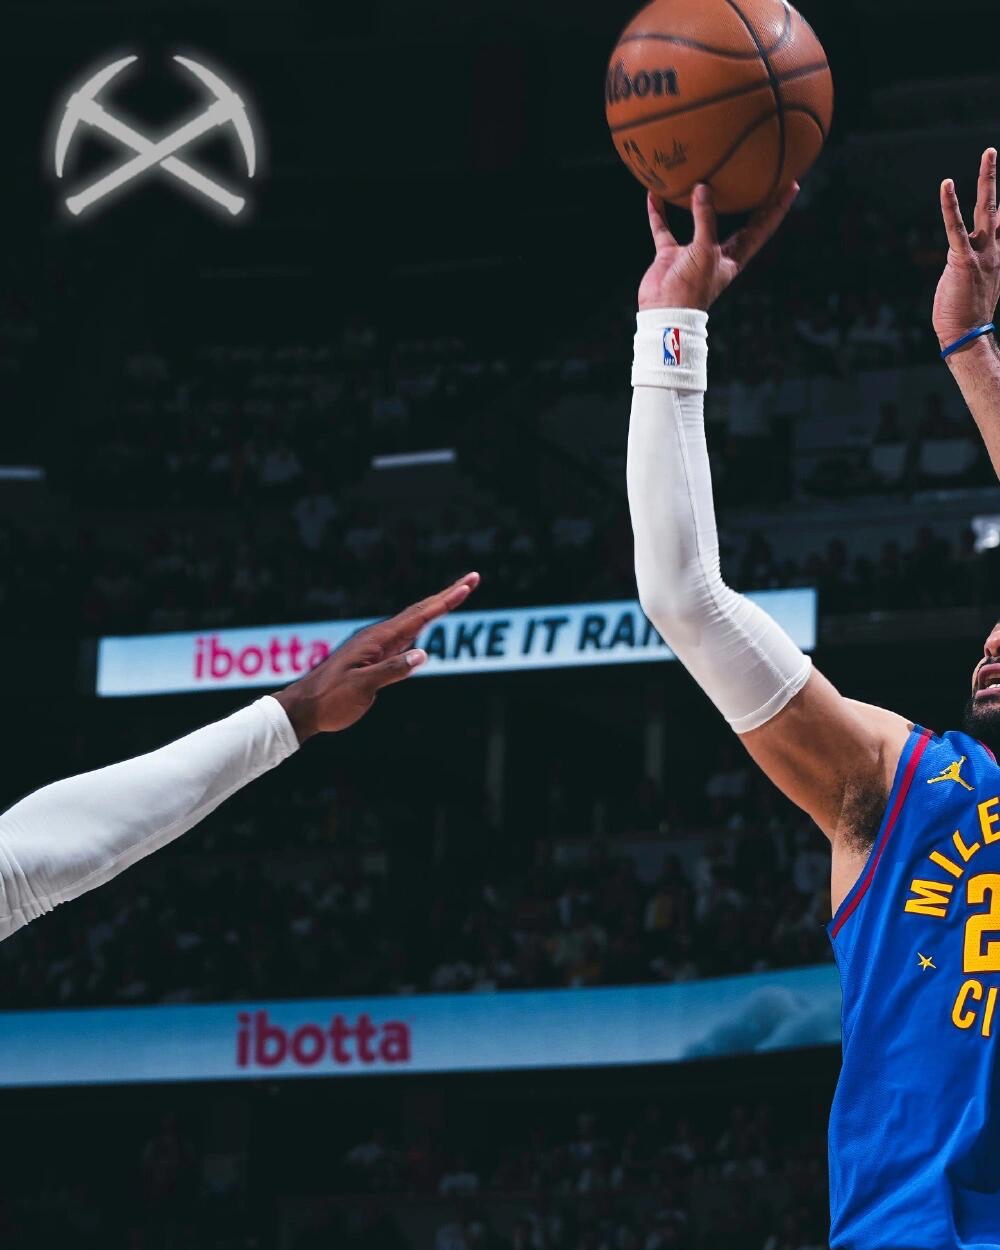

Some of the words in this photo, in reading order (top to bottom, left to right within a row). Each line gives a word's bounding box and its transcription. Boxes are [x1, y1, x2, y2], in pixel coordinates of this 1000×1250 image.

[413, 616, 512, 662] AKE
[522, 613, 570, 656] IT
[236, 1010, 410, 1068] ibotta
